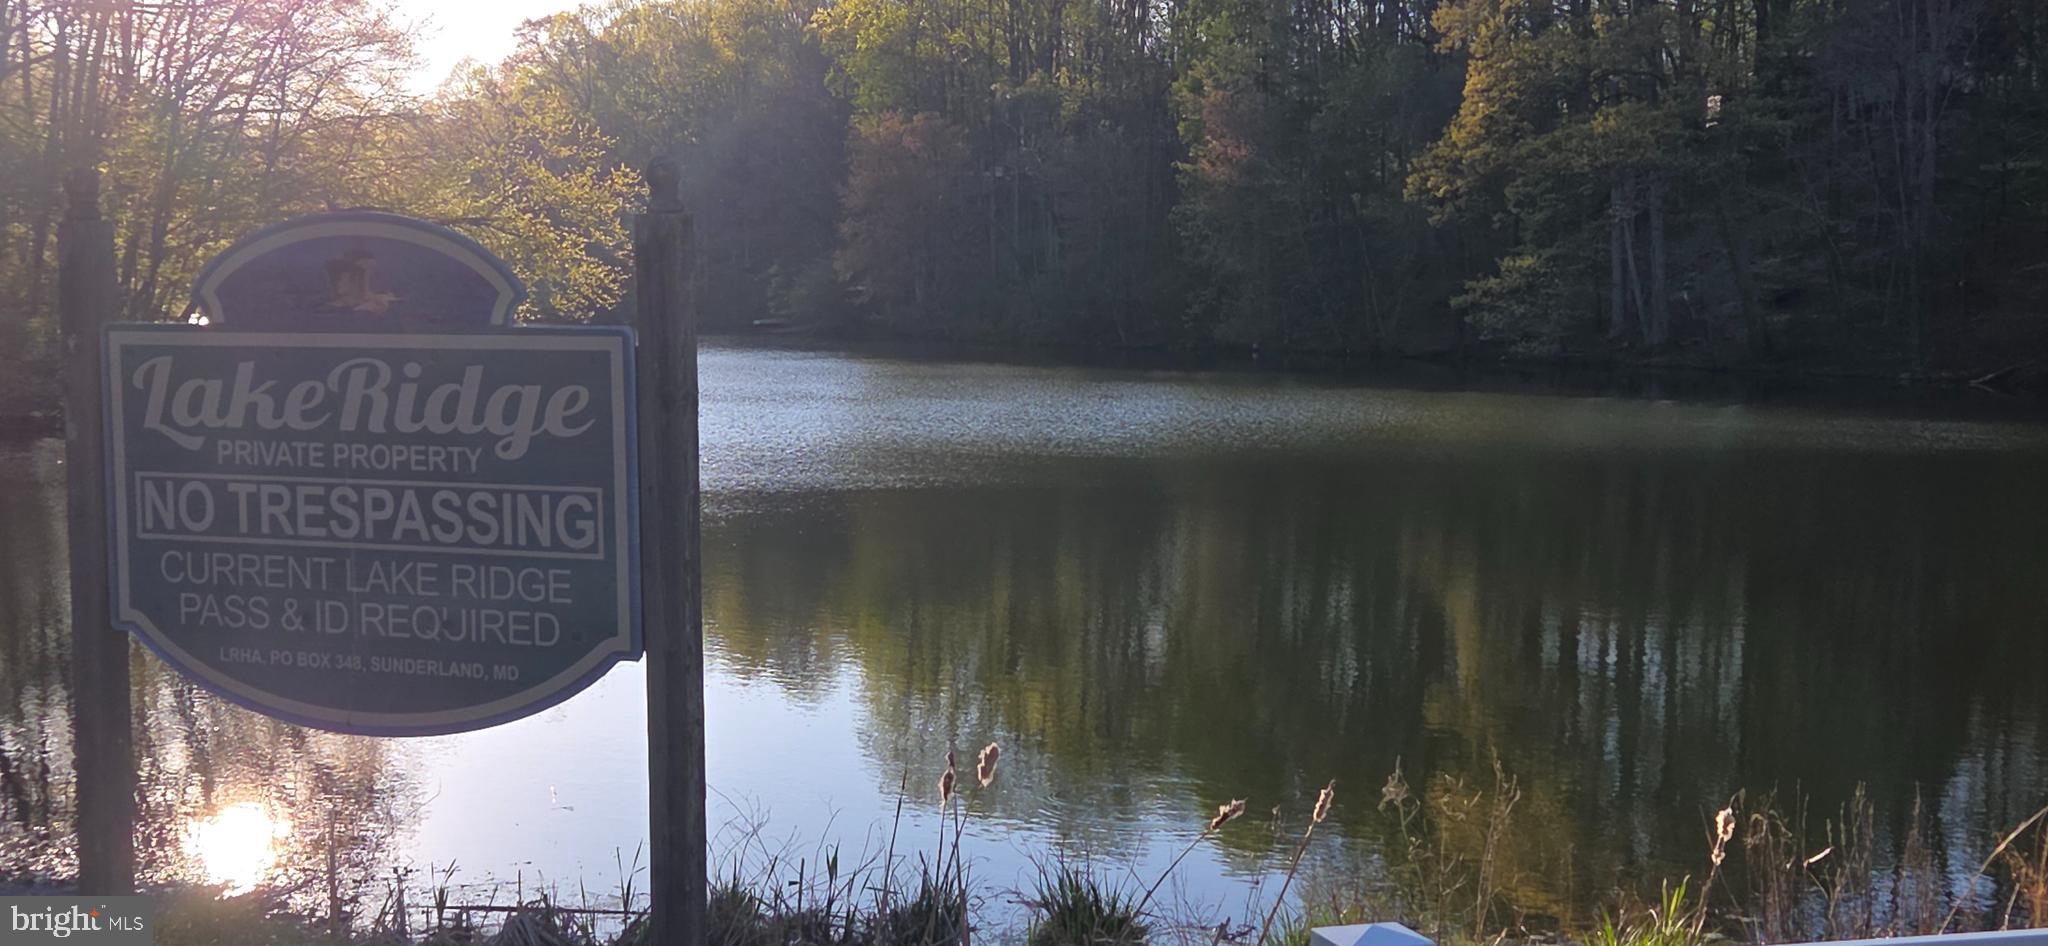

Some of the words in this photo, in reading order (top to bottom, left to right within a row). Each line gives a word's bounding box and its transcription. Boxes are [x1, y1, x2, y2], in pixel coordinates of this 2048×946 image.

[216, 439, 325, 467] PRIVATE
[333, 444, 482, 473] PROPERTY
[142, 480, 215, 534] NO
[227, 483, 597, 549] TRESPASSING
[159, 551, 336, 591] CURRENT
[345, 557, 440, 596] LAKE
[451, 566, 573, 603] RIDGE
[179, 593, 271, 631] PASS
[279, 599, 305, 633] &
[314, 601, 348, 635] ID
[361, 605, 561, 648] REQUIRED
[219, 646, 266, 667] LRHA,
[269, 650, 293, 667] PO
[297, 653, 332, 671] BOX
[370, 657, 490, 683] SUNDERLAND,
[493, 664, 520, 681] MD
